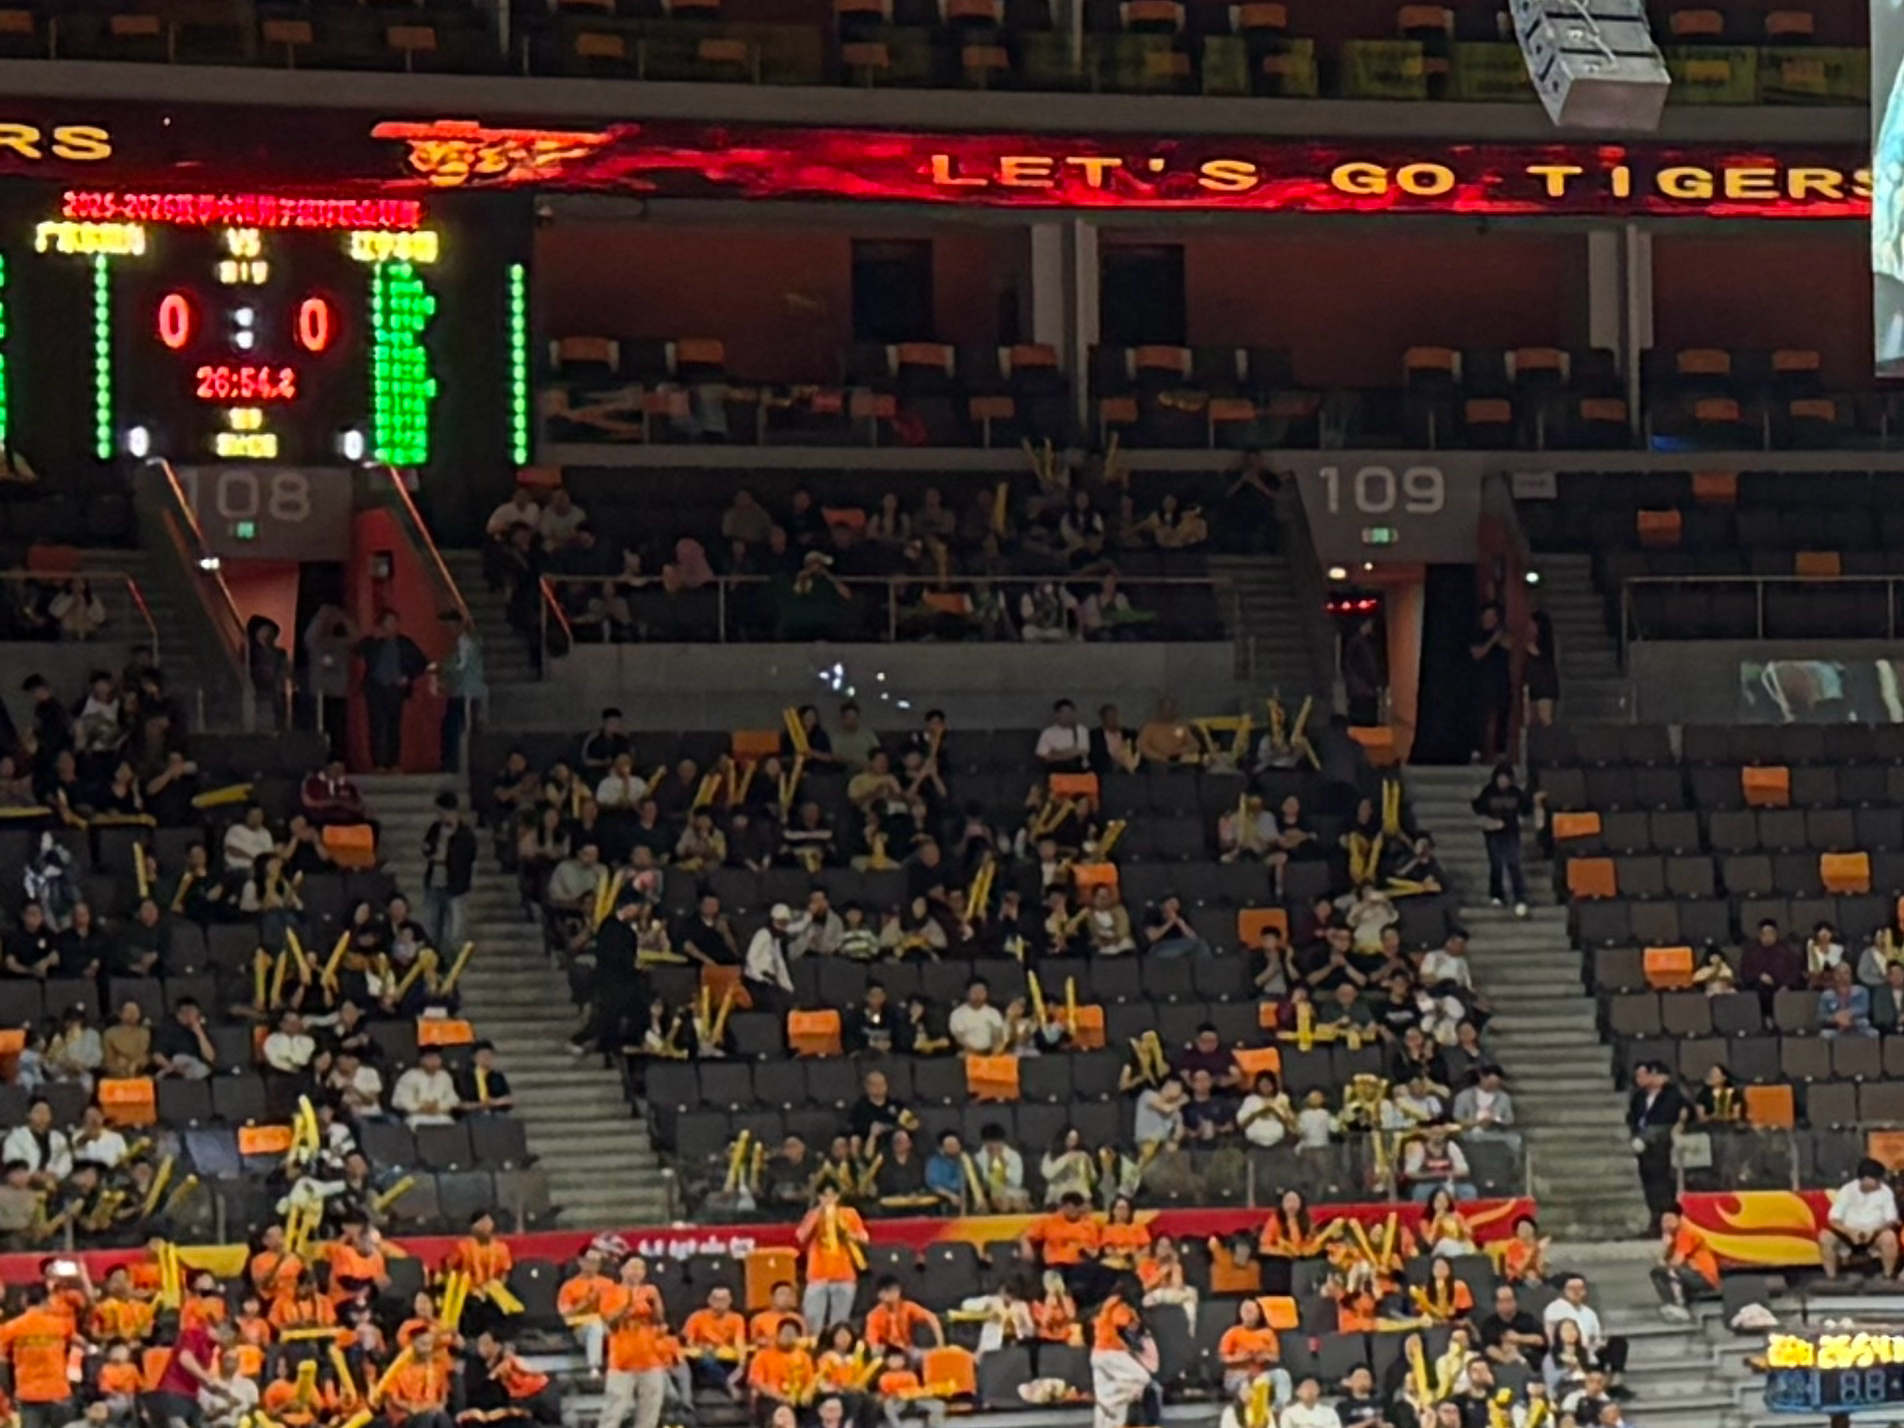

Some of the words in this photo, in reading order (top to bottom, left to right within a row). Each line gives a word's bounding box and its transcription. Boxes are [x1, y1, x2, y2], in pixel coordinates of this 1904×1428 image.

[931, 153, 1259, 194] LET'S
[1331, 161, 1456, 198] GO
[225, 227, 261, 258] VS
[159, 293, 190, 349] 0
[299, 297, 329, 351] 0
[1318, 465, 1446, 515] 109
